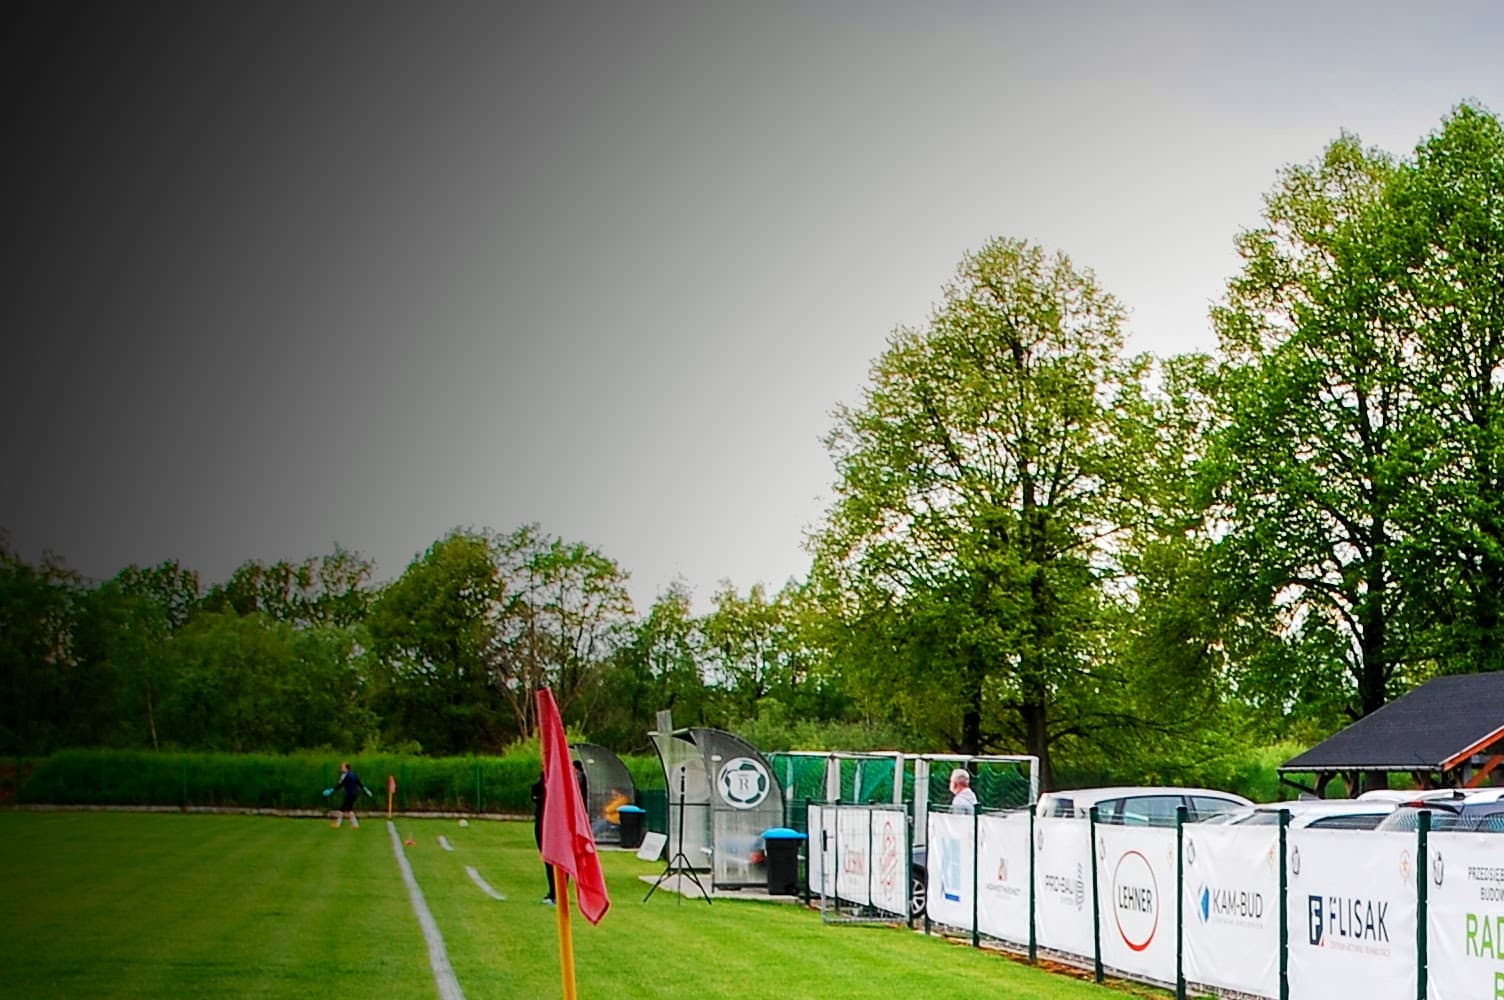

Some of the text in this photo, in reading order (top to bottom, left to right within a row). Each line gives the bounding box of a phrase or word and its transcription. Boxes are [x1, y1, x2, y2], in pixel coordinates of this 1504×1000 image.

[1118, 884, 1153, 914] LEHNER
[1213, 888, 1264, 919] KAM-BUD
[1328, 895, 1390, 943] FLISAK
